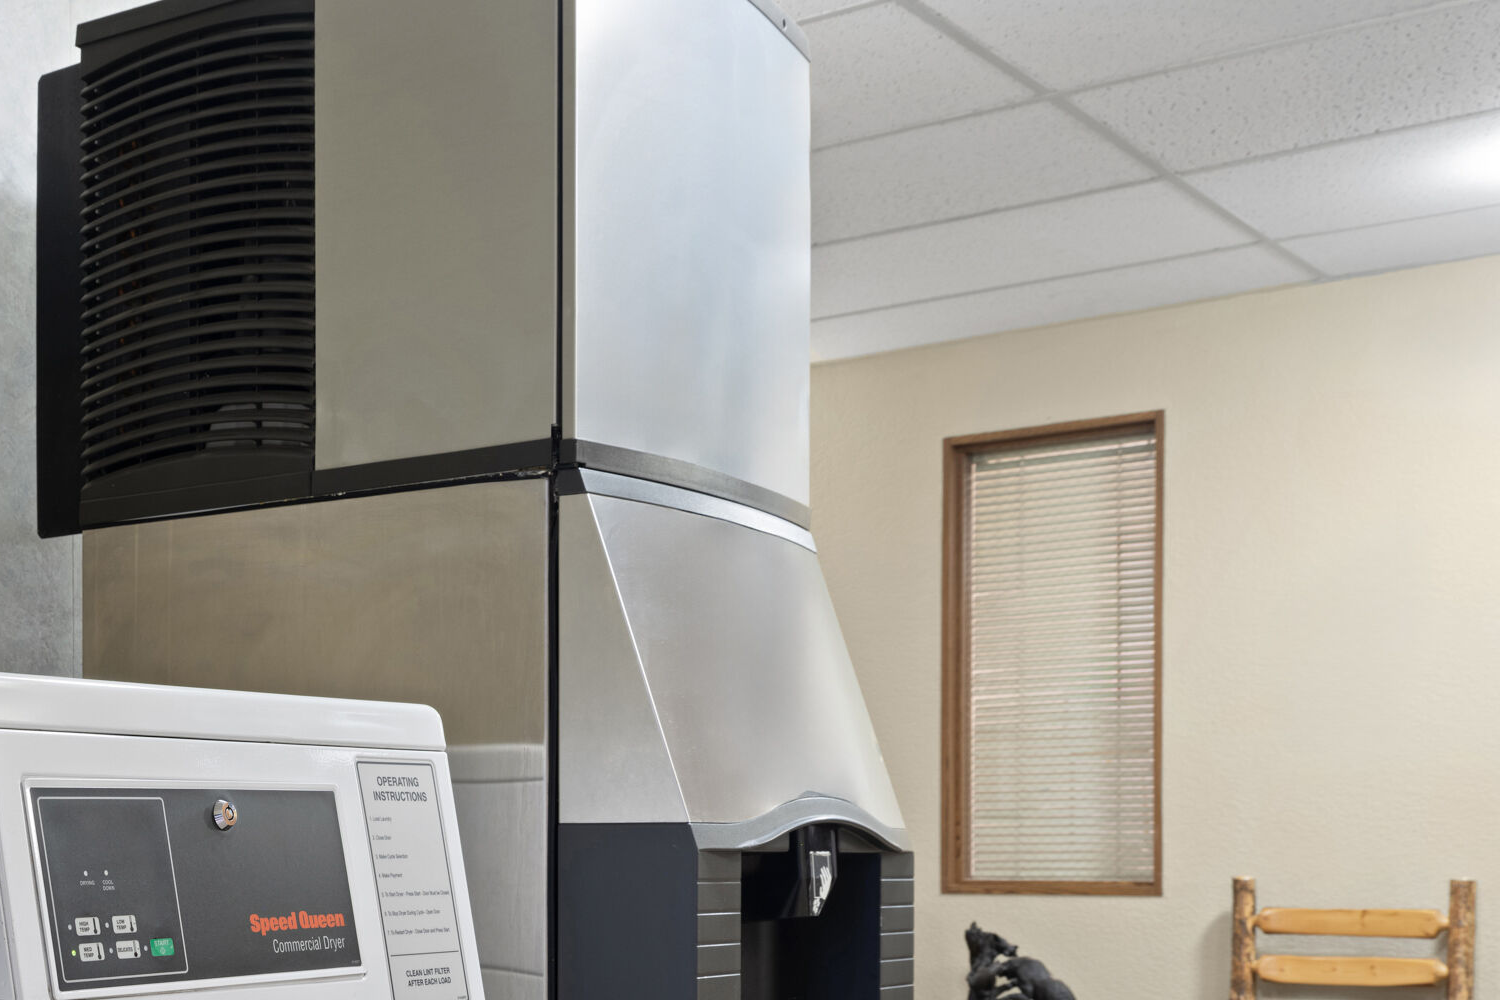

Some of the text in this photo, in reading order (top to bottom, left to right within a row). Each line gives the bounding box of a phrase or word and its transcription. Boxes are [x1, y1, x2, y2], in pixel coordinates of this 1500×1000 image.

[376, 776, 419, 787] OPERATING
[373, 791, 428, 802] INSTRUCTIONS
[249, 911, 345, 936] Speed Queen
[273, 936, 345, 953] Commercial Dryer
[408, 979, 424, 987] AFTER
